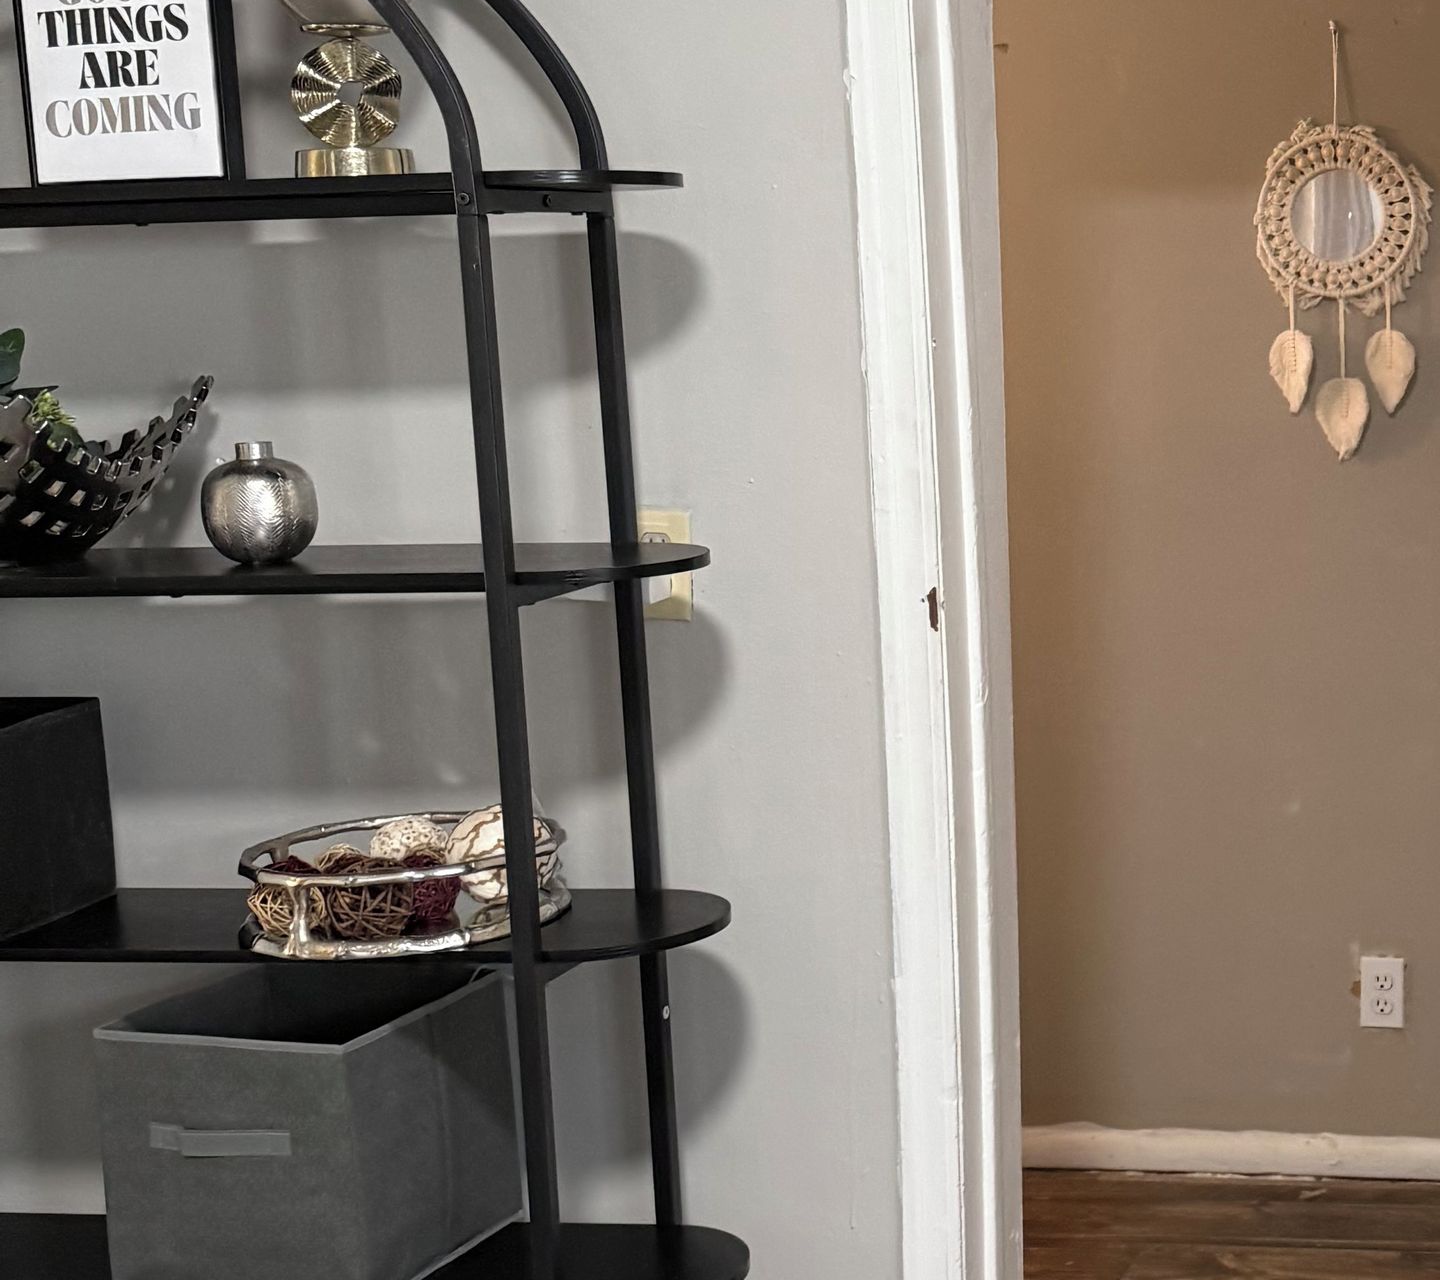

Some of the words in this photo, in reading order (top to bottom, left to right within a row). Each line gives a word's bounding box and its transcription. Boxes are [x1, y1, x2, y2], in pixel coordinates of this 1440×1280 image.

[37, 3, 189, 48] THINGS
[78, 48, 160, 90] ARE
[45, 91, 202, 138] COMING
